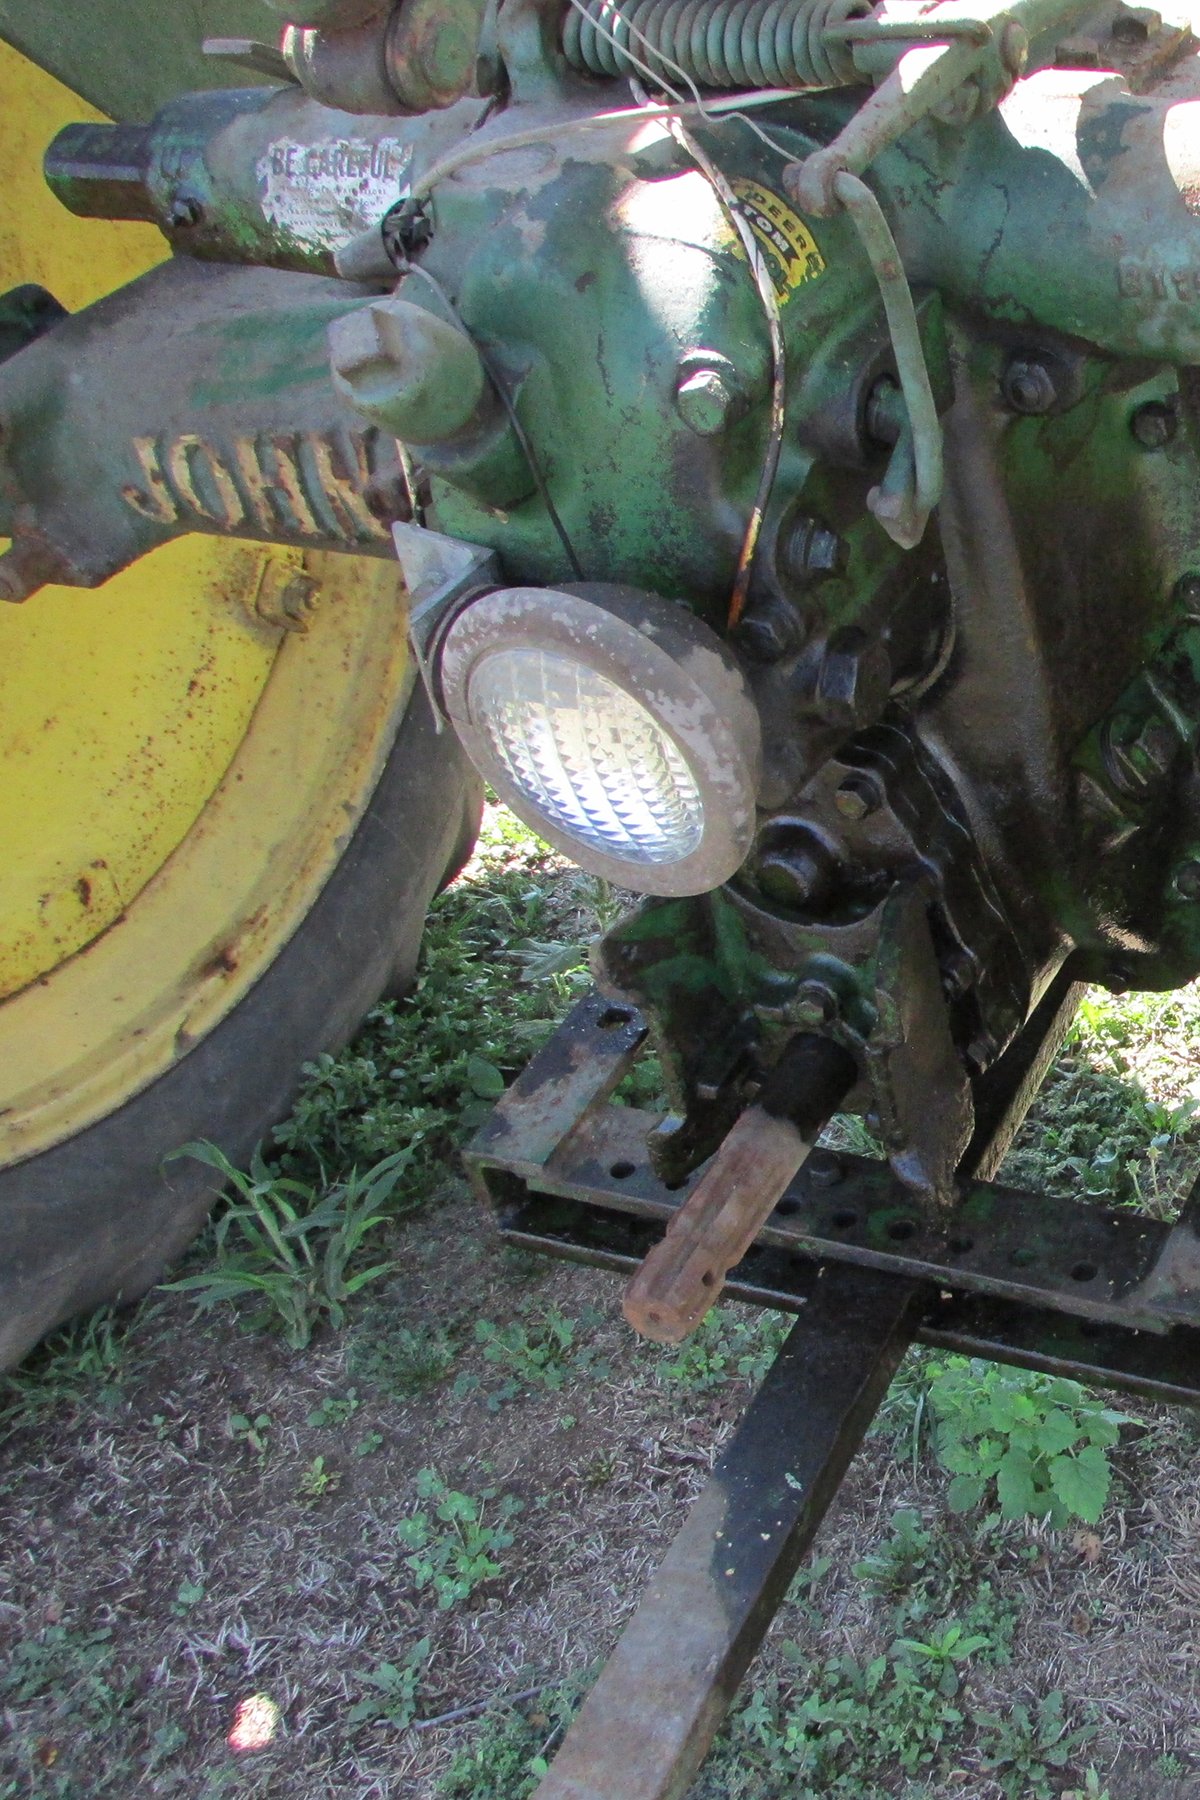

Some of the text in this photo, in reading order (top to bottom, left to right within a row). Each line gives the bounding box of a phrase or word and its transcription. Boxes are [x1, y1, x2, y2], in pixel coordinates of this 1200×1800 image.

[270, 143, 396, 181] BE CAREFUL
[120, 432, 392, 542] JOHN
